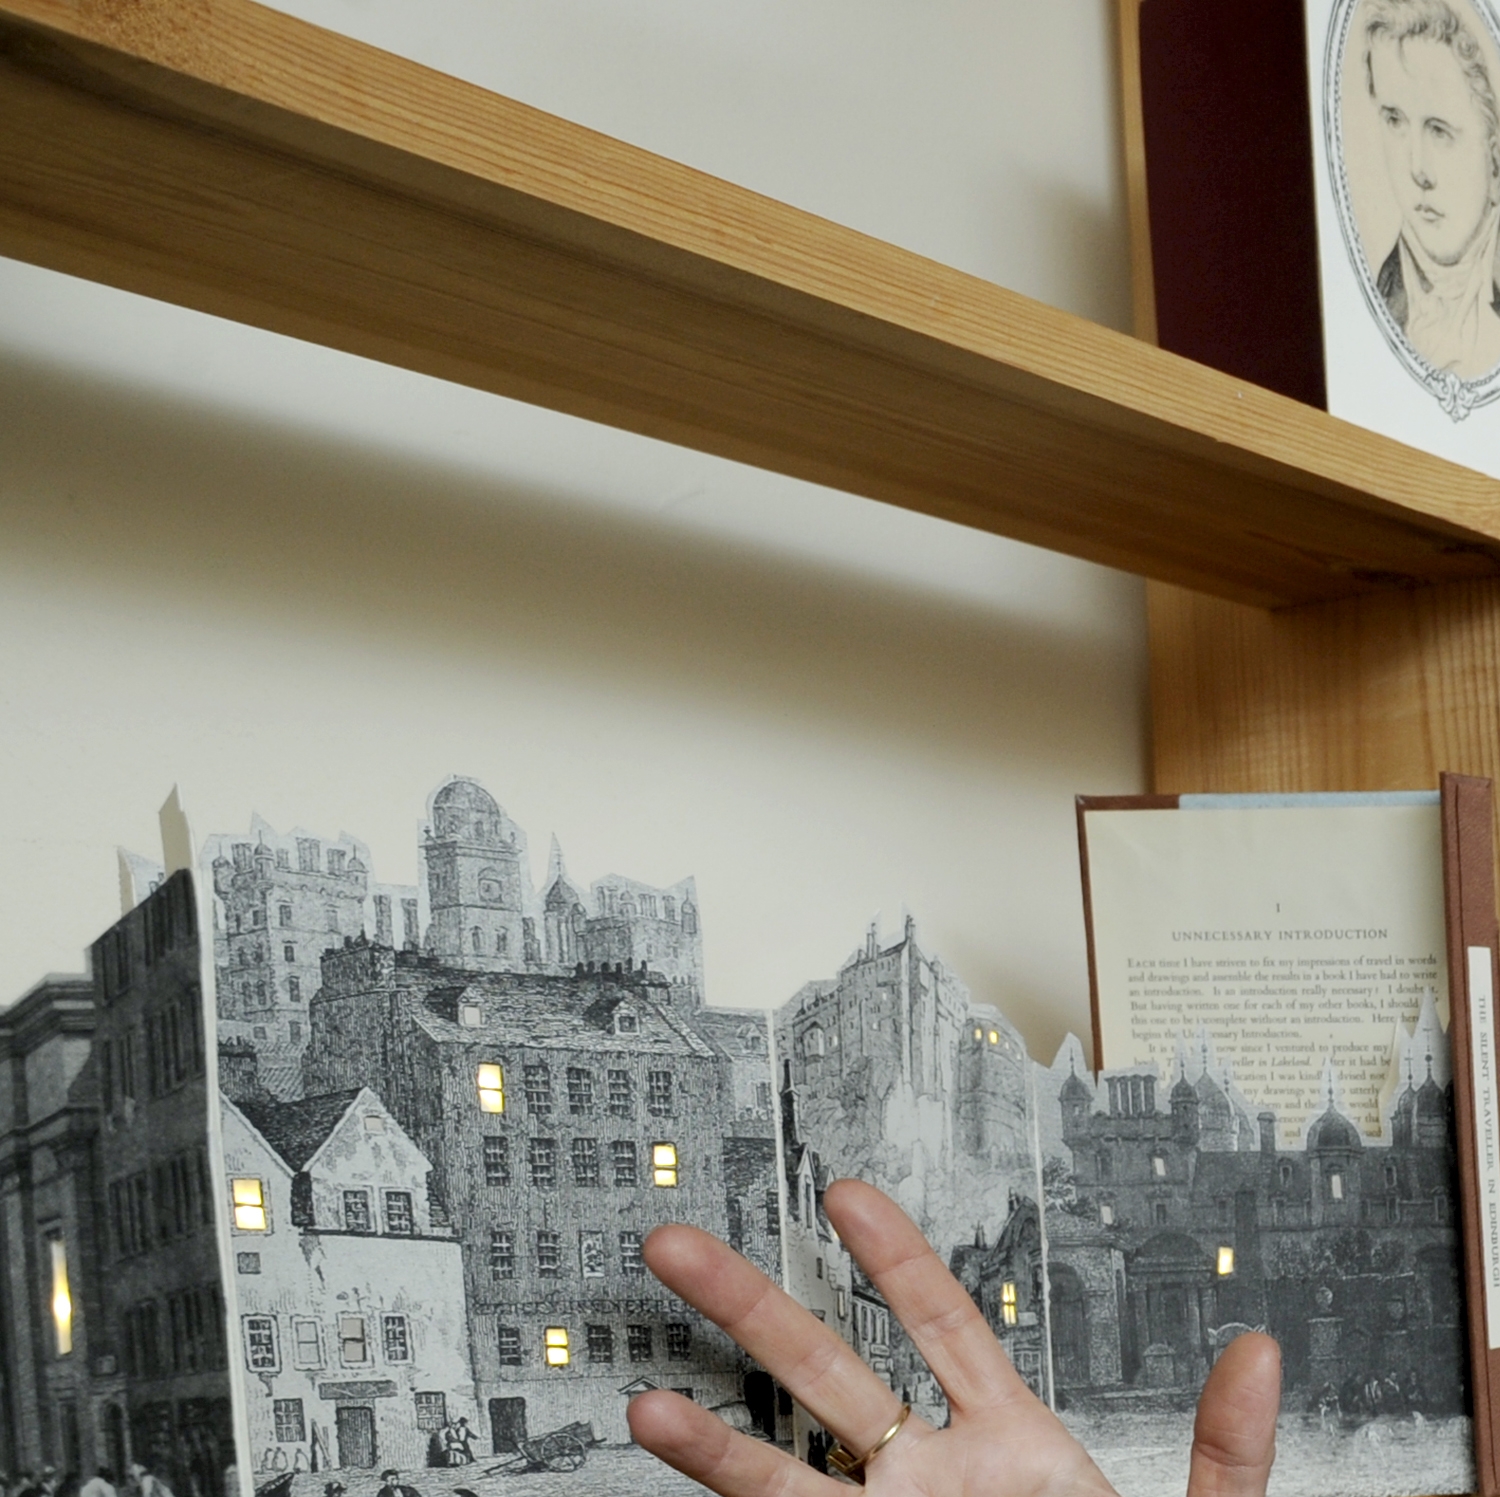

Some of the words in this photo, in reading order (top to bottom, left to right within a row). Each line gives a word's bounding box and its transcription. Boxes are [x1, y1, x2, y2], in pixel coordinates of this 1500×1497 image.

[1171, 930, 1273, 942] UNNECESSARY
[1278, 928, 1389, 941] INTRODUCTION
[1158, 957, 1180, 968] time
[1191, 956, 1213, 968] have
[1215, 957, 1247, 968] striven
[1249, 958, 1260, 968] to
[1262, 956, 1276, 968] fix
[1278, 957, 1294, 970] my
[1297, 955, 1350, 969] impressions
[1353, 954, 1365, 966] of
[1366, 954, 1392, 966] travel
[1395, 955, 1405, 965] in
[1408, 953, 1437, 965] words
[1128, 971, 1145, 982] and
[1147, 971, 1190, 985] drawings
[1192, 971, 1209, 982] and
[1212, 970, 1251, 982] assemble
[1254, 970, 1269, 981] the
[1272, 970, 1300, 981] results
[1302, 970, 1312, 981] in
[1323, 969, 1346, 981] book
[1355, 969, 1377, 981] have
[1379, 968, 1397, 980] had
[1399, 970, 1410, 980] to
[1412, 969, 1438, 980] write
[1129, 987, 1140, 997] an
[1224, 987, 1236, 996] an
[1240, 984, 1298, 996] introduction
[1301, 984, 1327, 998] really
[1395, 983, 1424, 994] doubt
[1130, 1001, 1147, 1011] But
[1150, 1001, 1183, 1013] having
[1186, 1001, 1220, 1011] written
[1223, 1002, 1241, 1010] one
[1243, 1000, 1258, 1010] for
[1261, 999, 1282, 1010] each
[1285, 999, 1298, 1010] of
[1300, 1001, 1315, 1012] my
[1318, 999, 1343, 1010] other
[1346, 998, 1377, 1011] books,
[1387, 997, 1419, 1009] should
[1479, 994, 1487, 1024] THE
[1130, 1014, 1148, 1025] this
[1150, 1016, 1168, 1025] one
[1169, 1016, 1180, 1025] to
[1183, 1014, 1193, 1025] be
[1250, 1013, 1287, 1024] without
[1290, 1015, 1301, 1024] an
[1372, 1012, 1395, 1023] Here
[1132, 1028, 1162, 1042] begins
[1148, 1043, 1156, 1053] It
[1215, 1044, 1237, 1053] now
[1240, 1043, 1263, 1053] since
[1275, 1041, 1316, 1053] ventured
[1319, 1043, 1329, 1052] to
[1332, 1041, 1369, 1056] produce
[1373, 1043, 1389, 1055] my
[1480, 1030, 1490, 1081] SILENT
[1359, 1055, 1377, 1067] had
[1278, 1071, 1296, 1080] was
[1263, 1084, 1305, 1099] drawings
[1349, 1083, 1380, 1097] utterly
[1284, 1098, 1301, 1109] and
[1349, 1098, 1379, 1109] would
[1482, 1086, 1496, 1172] TRAVELLER
[1487, 1178, 1496, 1194] IN
[1488, 1202, 1500, 1289] EDINBURGH
